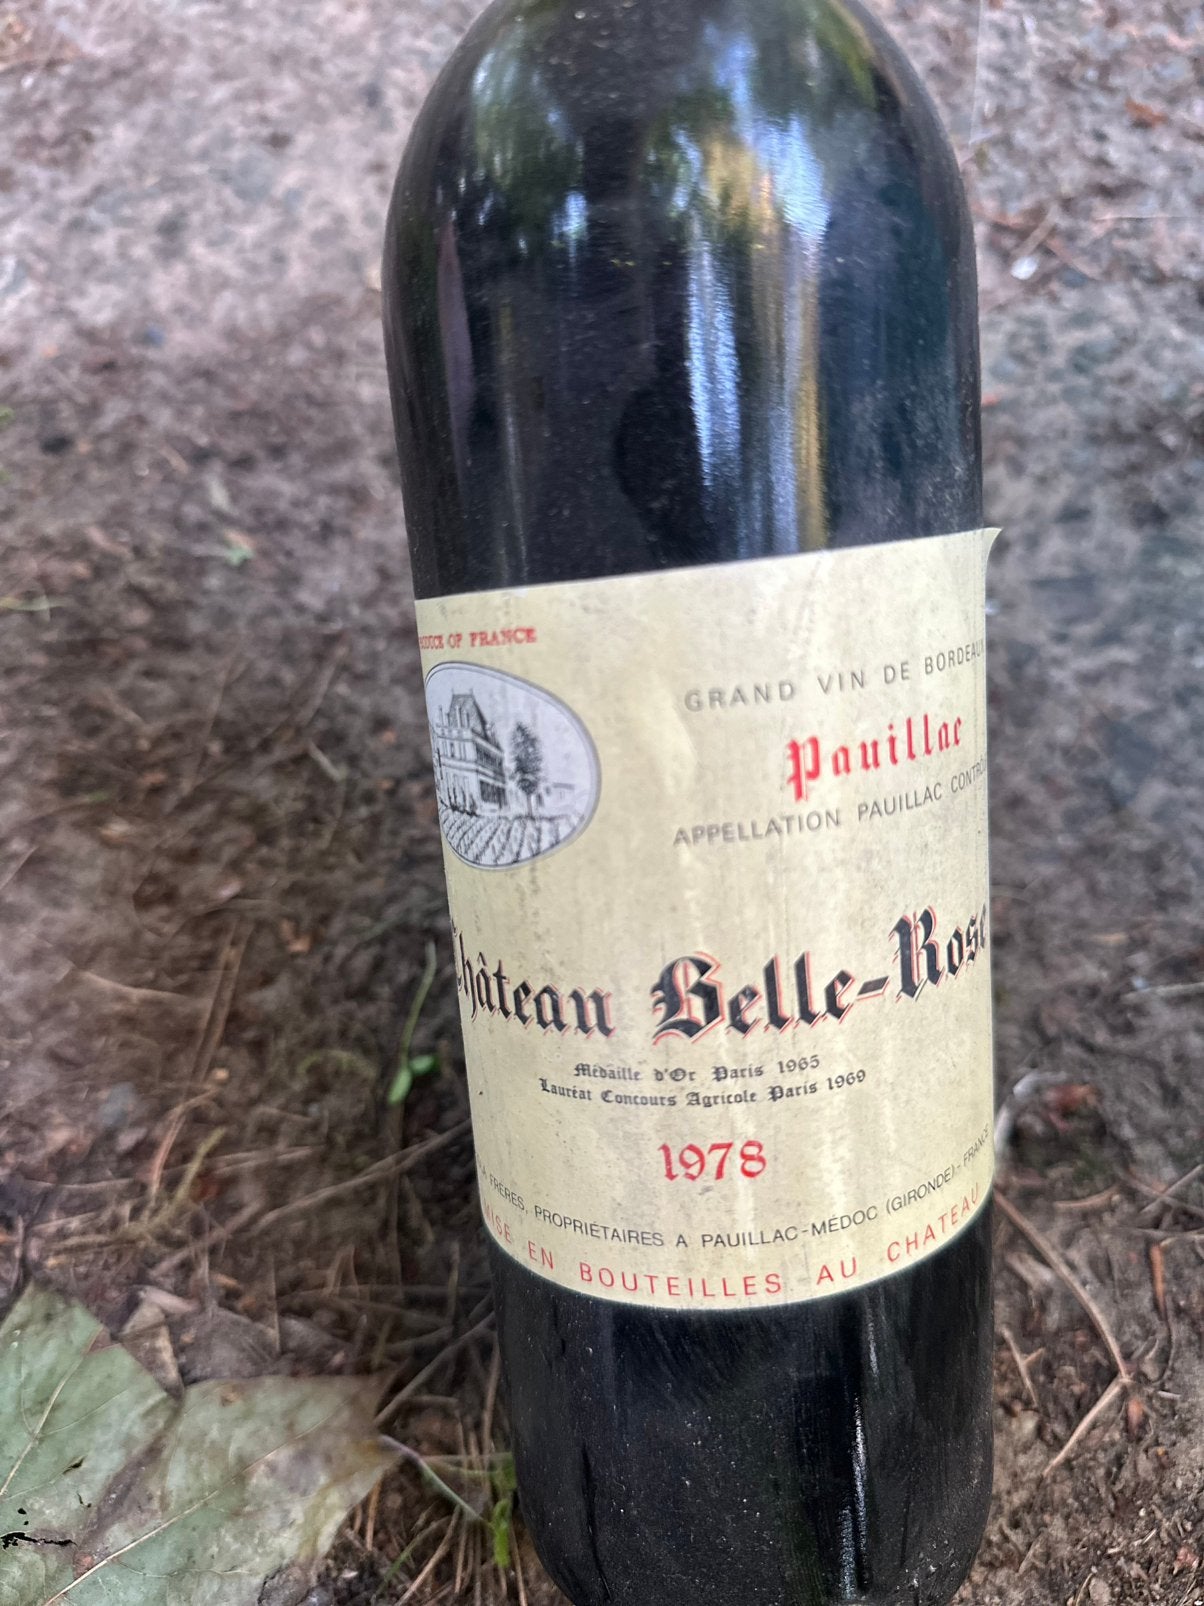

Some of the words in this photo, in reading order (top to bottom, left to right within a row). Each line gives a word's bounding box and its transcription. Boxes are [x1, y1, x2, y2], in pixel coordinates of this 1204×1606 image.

[448, 632, 463, 649] OF
[470, 626, 538, 648] FRANCE
[684, 680, 796, 712] GRAND
[817, 670, 865, 695] VIN
[883, 661, 911, 685] DE
[786, 713, 962, 802] Pauillac
[673, 808, 841, 847] APPELLATION
[857, 782, 942, 821] PAUILLAC
[451, 917, 616, 1040] hâteau
[539, 1077, 592, 1101] Lauréat
[600, 1089, 678, 1106] Concours
[686, 1090, 757, 1108] Agricole
[768, 1082, 818, 1102] Paris
[826, 1069, 867, 1091] 1969
[573, 1063, 641, 1081] Médaille
[653, 1067, 697, 1082] d'Or
[712, 1064, 764, 1082] Paris
[777, 1054, 820, 1074] 1965
[657, 1139, 767, 1182] 1978
[483, 1197, 512, 1244] MISE
[528, 1240, 554, 1270] EN
[579, 1261, 782, 1298] BOUTEILLES
[816, 1256, 858, 1286] AU
[886, 1181, 979, 1263] CHATEAU
[534, 1204, 665, 1247] PROPRIÉTAIRES
[675, 1234, 689, 1248] A
[701, 1204, 879, 1248] PAUILLAC-MÉDOC
